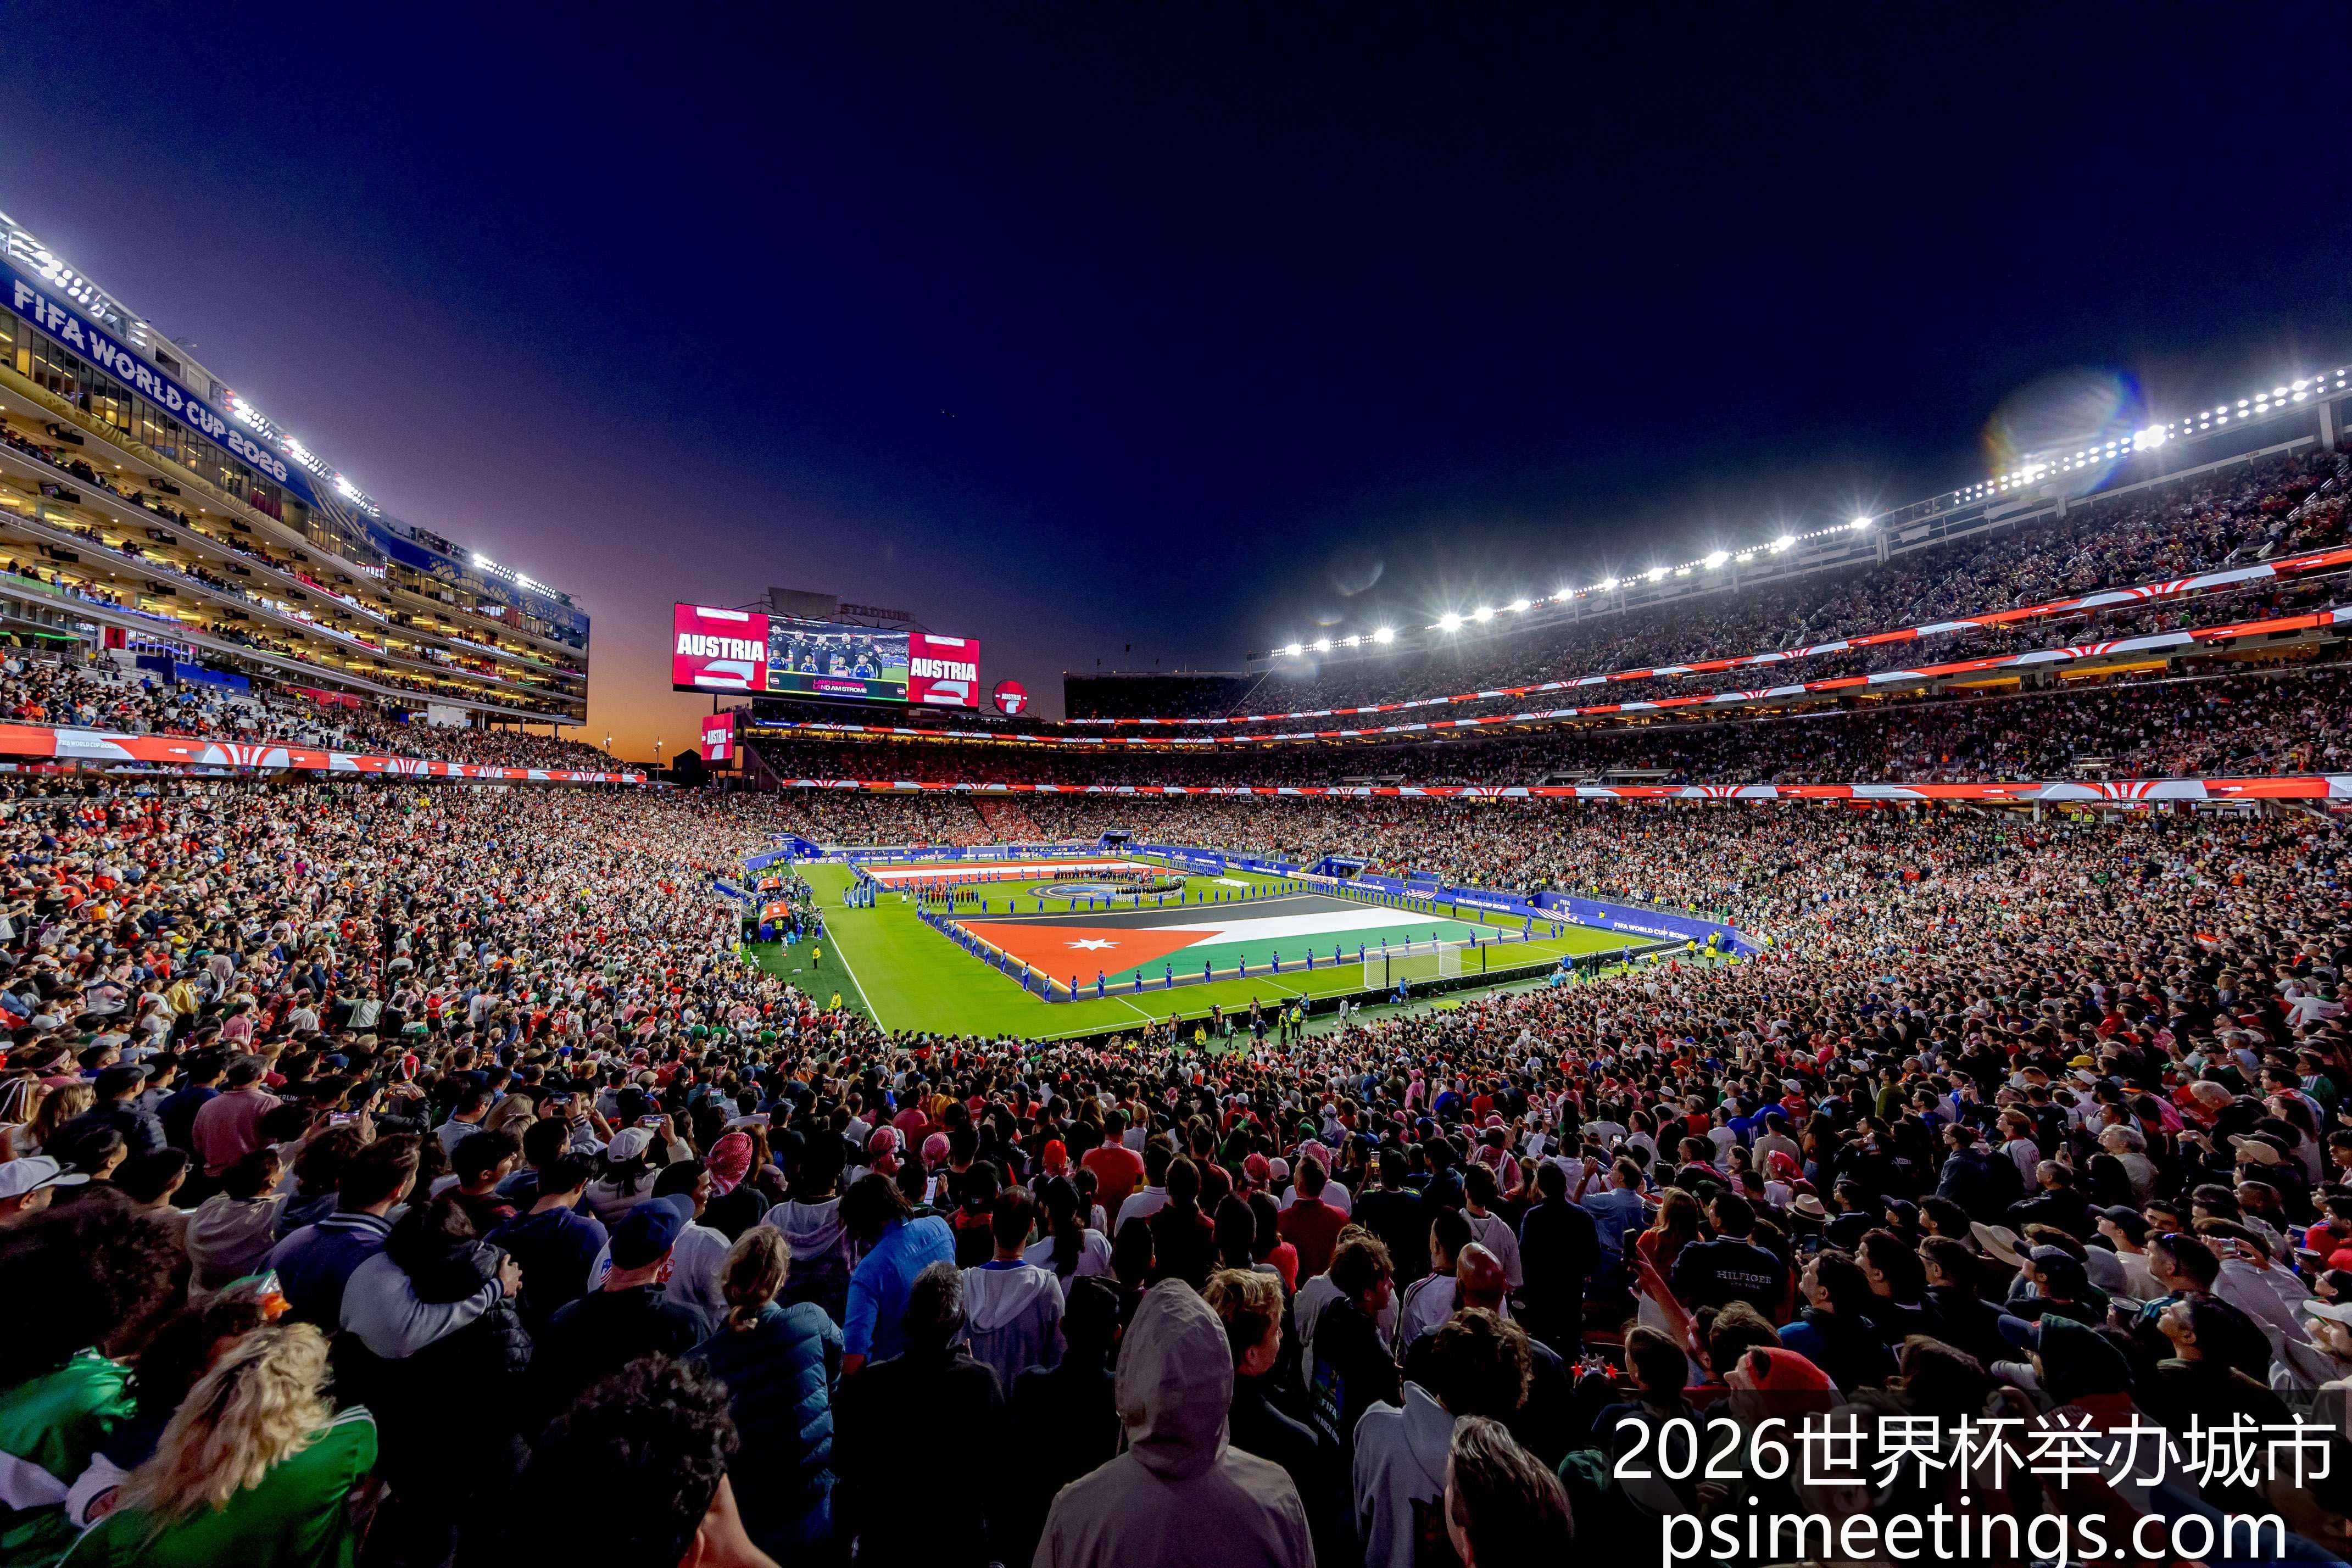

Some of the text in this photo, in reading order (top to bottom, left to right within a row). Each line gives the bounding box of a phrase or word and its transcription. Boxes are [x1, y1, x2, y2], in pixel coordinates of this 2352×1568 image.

[14, 279, 288, 483] FIFA WORLD CUP 2026
[677, 633, 765, 662] AUSTRIA
[910, 657, 977, 682] AUSTRIA
[707, 729, 726, 745] AUSTRIA
[1629, 925, 1653, 933] WORLD
[1716, 1270, 1771, 1284] HILFIGER
[1321, 1398, 1336, 1421] FIFA
